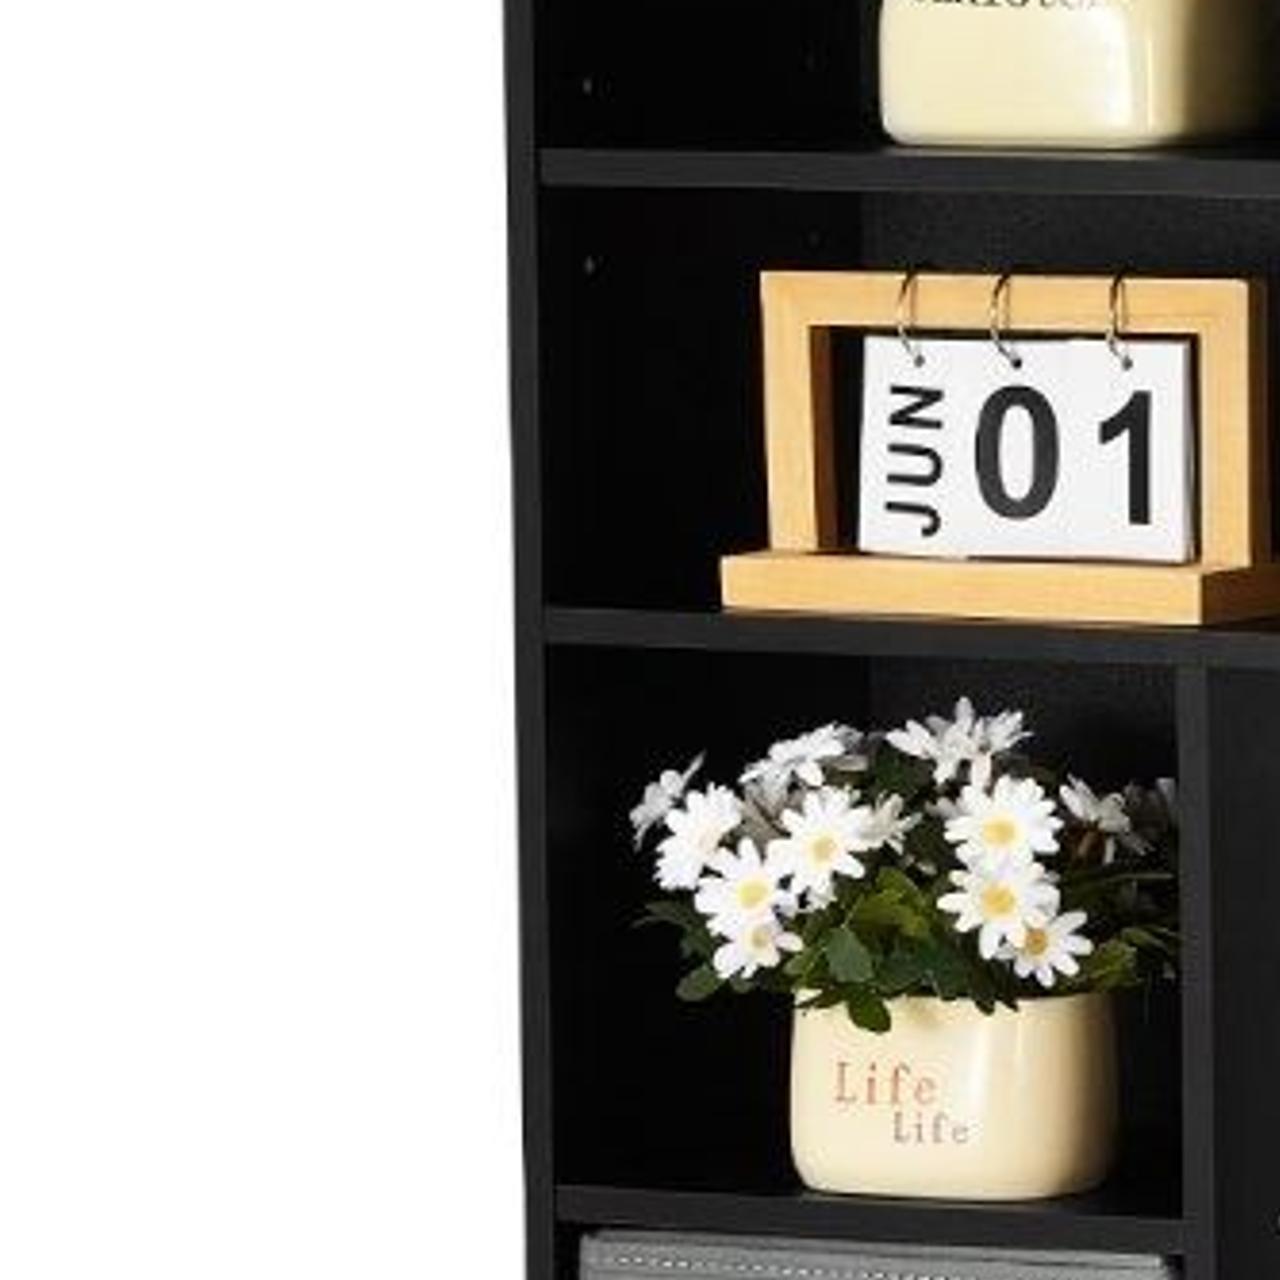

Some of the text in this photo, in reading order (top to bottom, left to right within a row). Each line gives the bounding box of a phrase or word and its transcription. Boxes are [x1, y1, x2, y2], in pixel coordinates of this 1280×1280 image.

[884, 384, 944, 538] JUN
[973, 384, 1153, 526] 01
[835, 1060, 938, 1106] Life
[893, 1110, 969, 1145] Life
